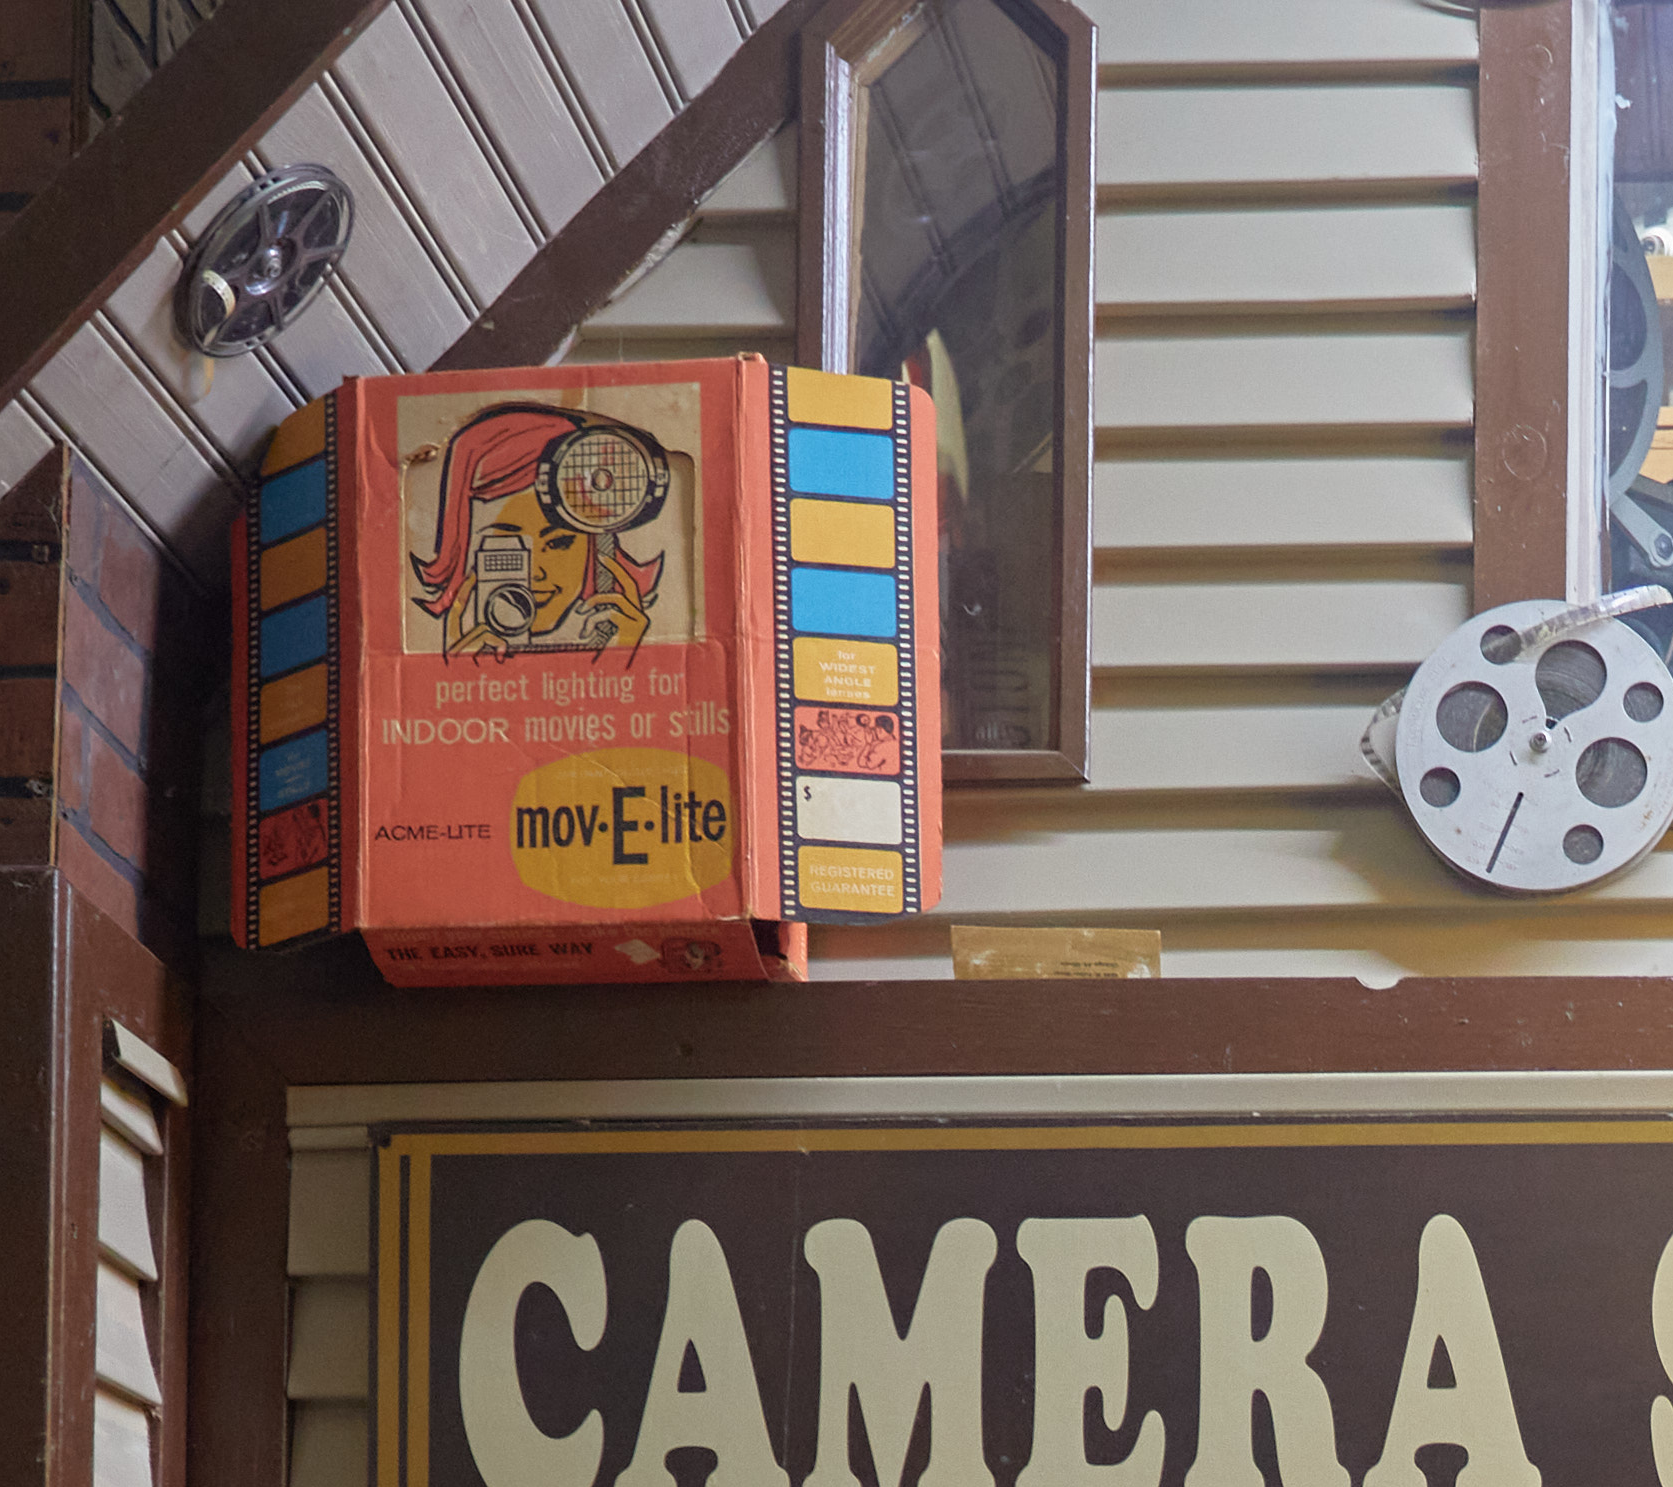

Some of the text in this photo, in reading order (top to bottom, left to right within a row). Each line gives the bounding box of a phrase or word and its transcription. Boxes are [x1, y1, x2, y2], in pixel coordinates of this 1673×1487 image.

[818, 661, 877, 675] WIDEST
[436, 668, 686, 709] perfect lighting for
[823, 675, 873, 688] ANGLE
[382, 703, 731, 746] INDOOR movies or stills
[803, 785, 812, 802] $
[374, 823, 492, 842] ACME-LITE
[809, 864, 895, 881] REGISTERED
[809, 880, 896, 898] GUARANTEE
[385, 947, 424, 962] THE
[489, 943, 543, 959] SURE
[548, 941, 595, 957] WAY
